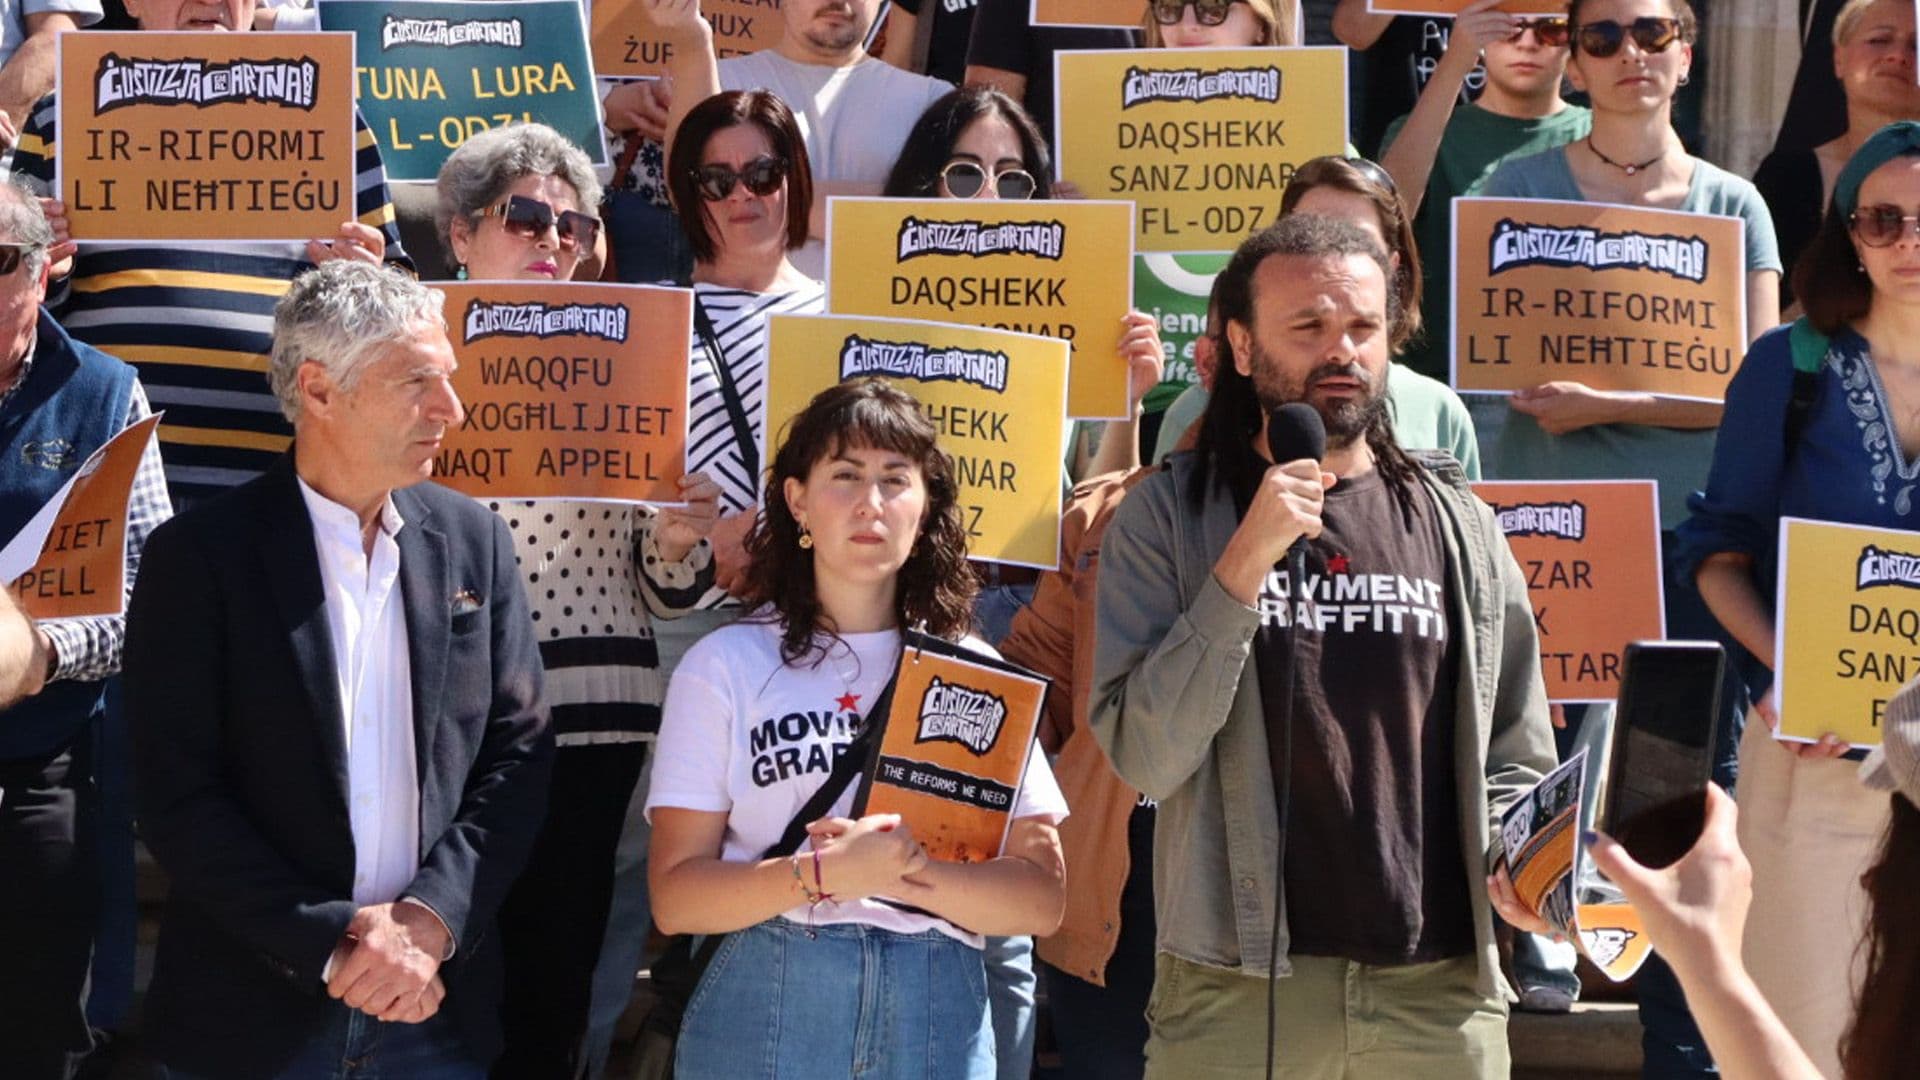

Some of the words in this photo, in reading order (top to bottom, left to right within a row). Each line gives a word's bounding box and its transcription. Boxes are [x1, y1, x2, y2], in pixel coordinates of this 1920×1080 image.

[472, 62, 576, 98] LURA
[86, 129, 326, 161] IR-RIFORMI
[389, 112, 534, 150] L-OD
[1118, 121, 1286, 153] DAQSHEKK
[74, 180, 117, 211] LI
[146, 170, 340, 211] NEĦTIEĠU
[1142, 206, 1265, 235] FL-ODZ
[891, 277, 1067, 312] DAQSHEKK
[1481, 287, 1717, 329] IR-RIFORMI
[480, 356, 613, 391] WAQQFU
[1467, 335, 1511, 364] LI
[1541, 335, 1733, 376] NEĦTIEĠU
[535, 449, 659, 481] APPELL
[1260, 598, 1444, 640] RAFFITTI
[884, 764, 905, 781] THE
[910, 771, 957, 793] REFORMS
[962, 785, 977, 798] WE
[980, 790, 1007, 805] NEED
